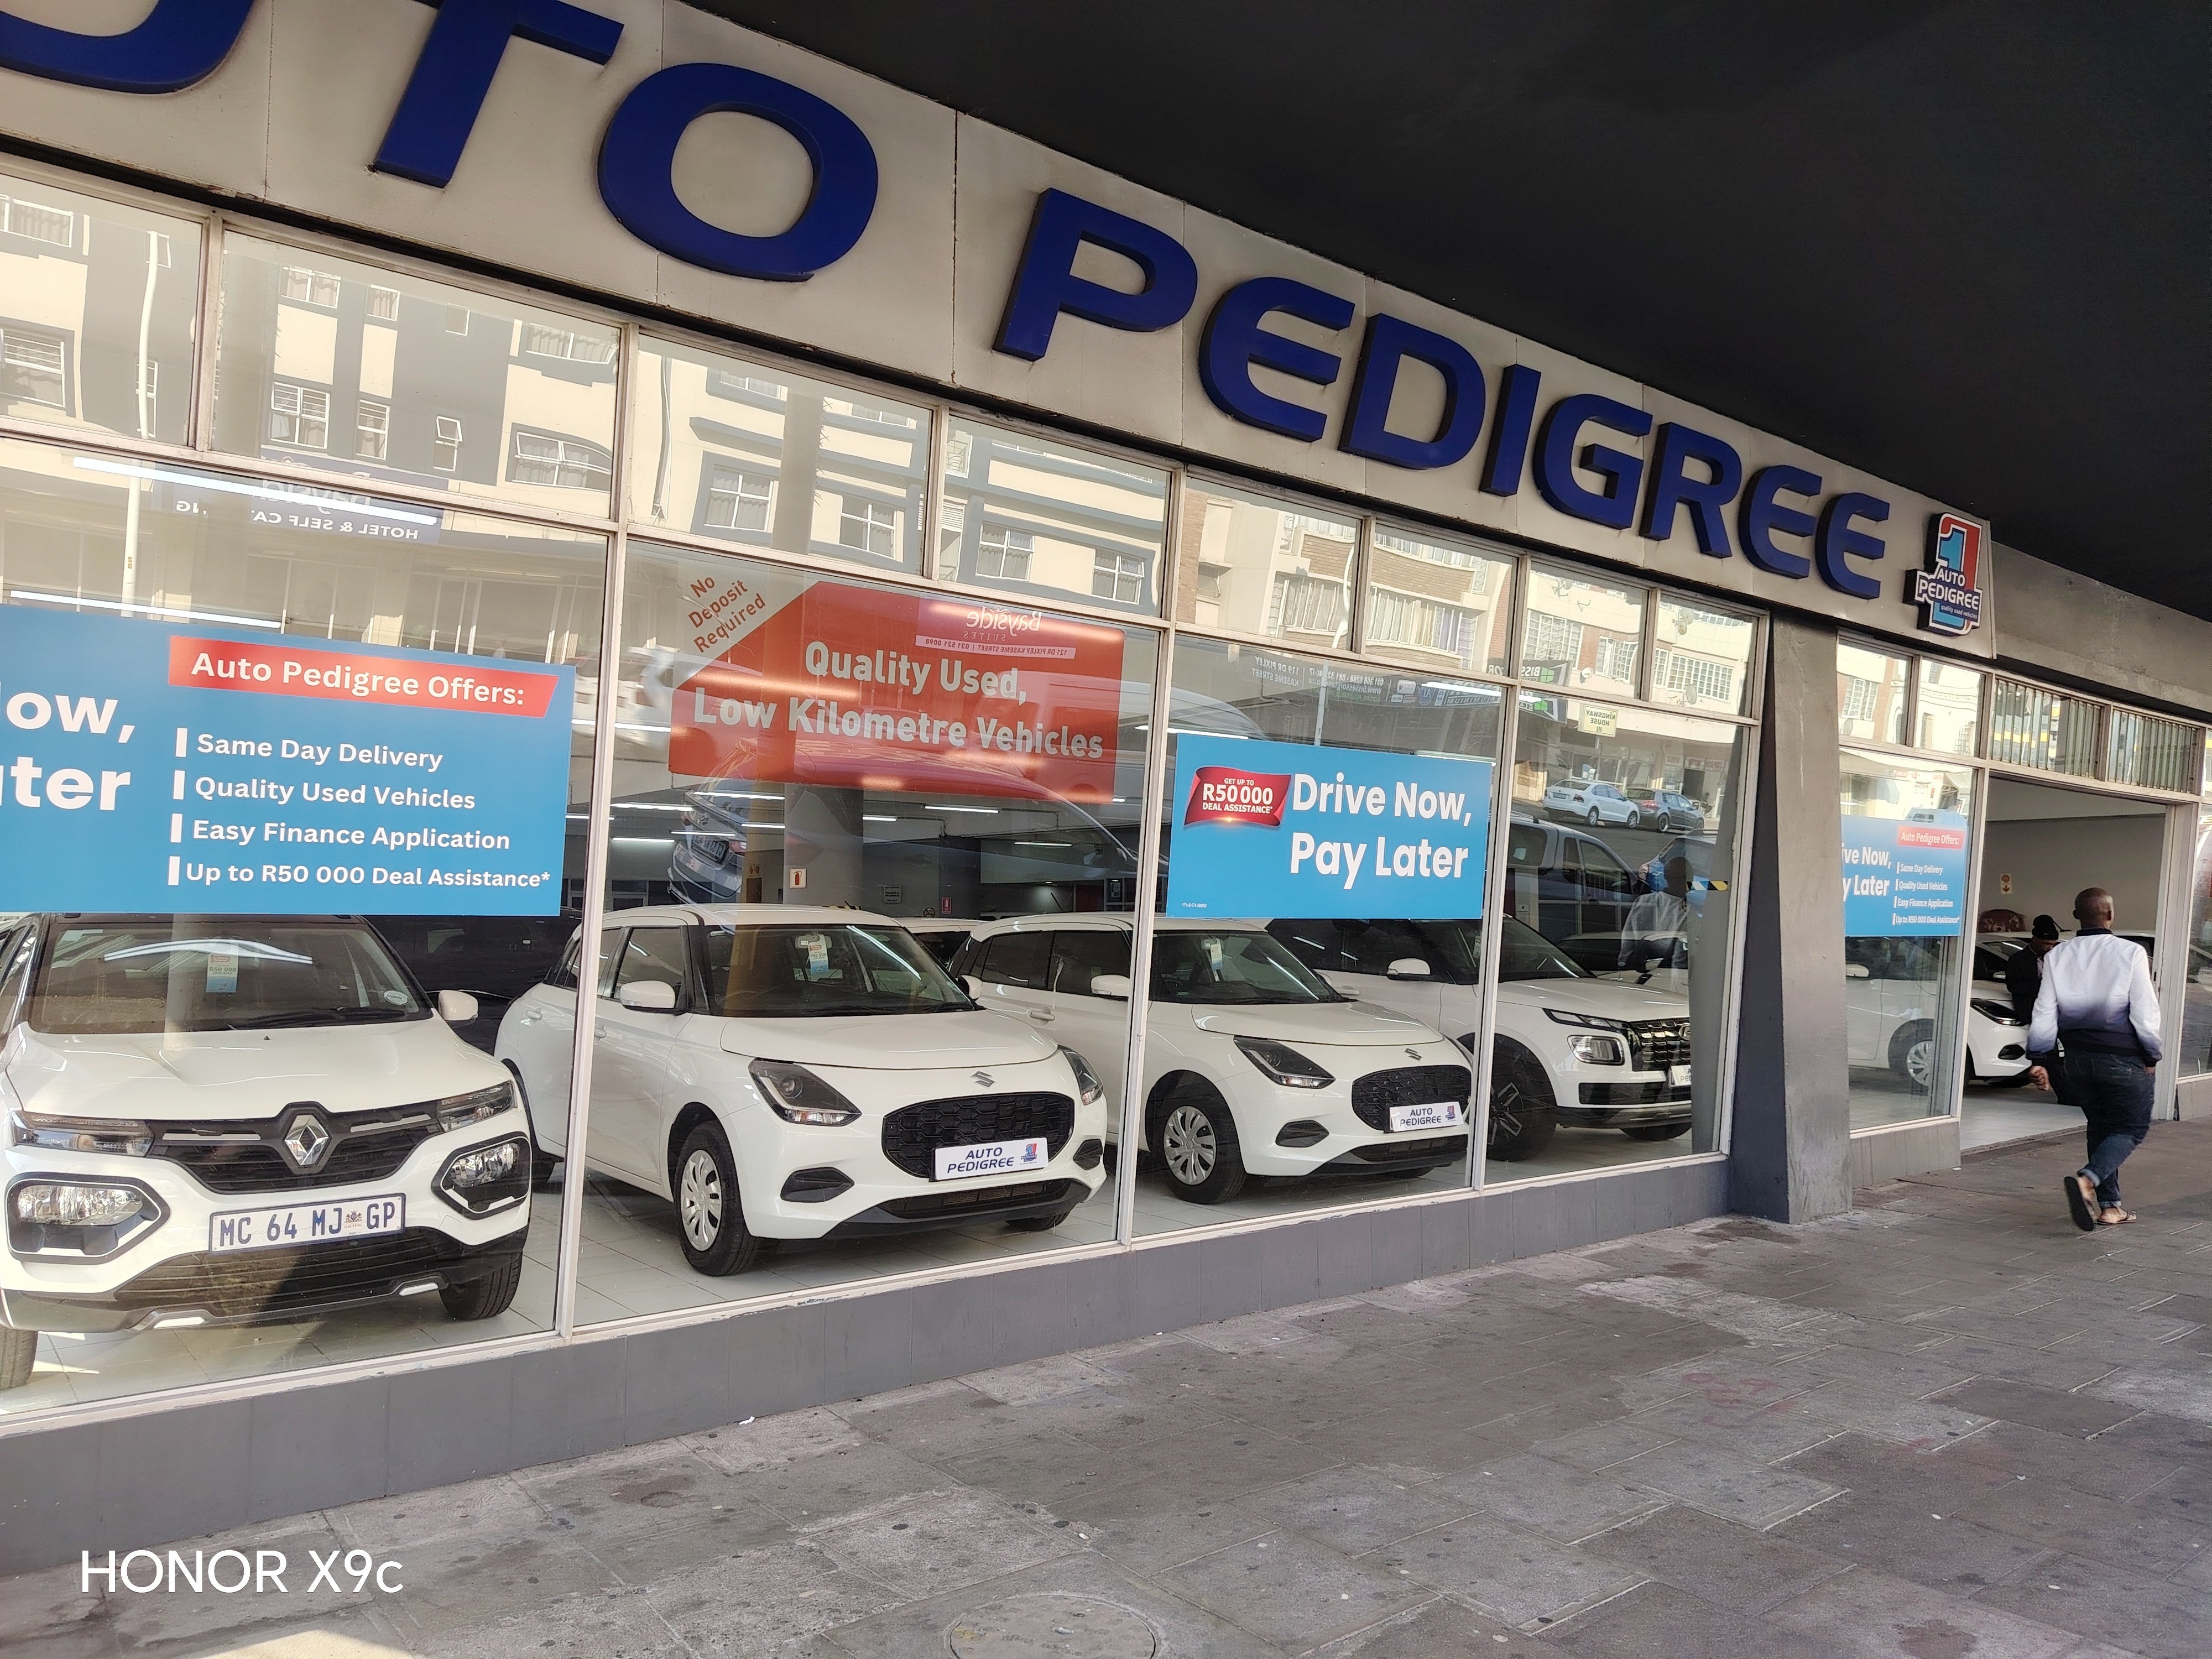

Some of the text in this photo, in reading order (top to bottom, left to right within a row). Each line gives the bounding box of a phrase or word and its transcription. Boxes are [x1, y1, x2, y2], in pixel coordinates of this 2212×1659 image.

[993, 187, 1890, 599] PEDIGREE
[690, 577, 715, 598] No
[1937, 568, 1965, 587] AUTO
[688, 580, 748, 628] Deposit
[1919, 579, 1979, 610] PEDIGREE
[693, 593, 766, 653] Required
[1940, 605, 1953, 613] quality
[1963, 610, 1978, 619] vehicles
[191, 652, 525, 705] Auto Pedigree Offers:
[805, 640, 1026, 706] Quality Used,
[6, 692, 135, 743] ow,
[693, 687, 1104, 759] Low Kilometre Vehicles
[197, 733, 444, 773] Same Day Delivery
[0, 757, 131, 811] ter
[194, 776, 476, 810] Quality Used Vehicles
[1202, 783, 1274, 805] R50 000
[1202, 802, 1222, 811] DEAL
[1292, 772, 1472, 827] Drive Now,
[192, 819, 510, 851] Easy Finance Application
[1901, 831, 1959, 846] Auto Pedigree Offers:
[1290, 832, 1469, 890] Pay Later
[1841, 842, 1892, 869] ive Now,
[186, 863, 221, 885] Up
[228, 864, 254, 882] to
[262, 865, 309, 883] R50
[316, 867, 365, 884] 000
[372, 867, 422, 885] Deal
[1900, 863, 1943, 876] Same Day Delivery
[1853, 874, 1890, 896] Later
[1898, 880, 1948, 891] Quality Used Vehicles
[1897, 898, 1953, 909] Easy Finance Application
[1895, 916, 1902, 925] Up
[1400, 1116, 1442, 1126] PEDIGREE
[1410, 1108, 1433, 1117] AUTO
[947, 1157, 1015, 1173] PEDIGREE
[965, 1147, 1003, 1160] AUTO
[220, 1202, 395, 1246] MC 64 MJ GP
